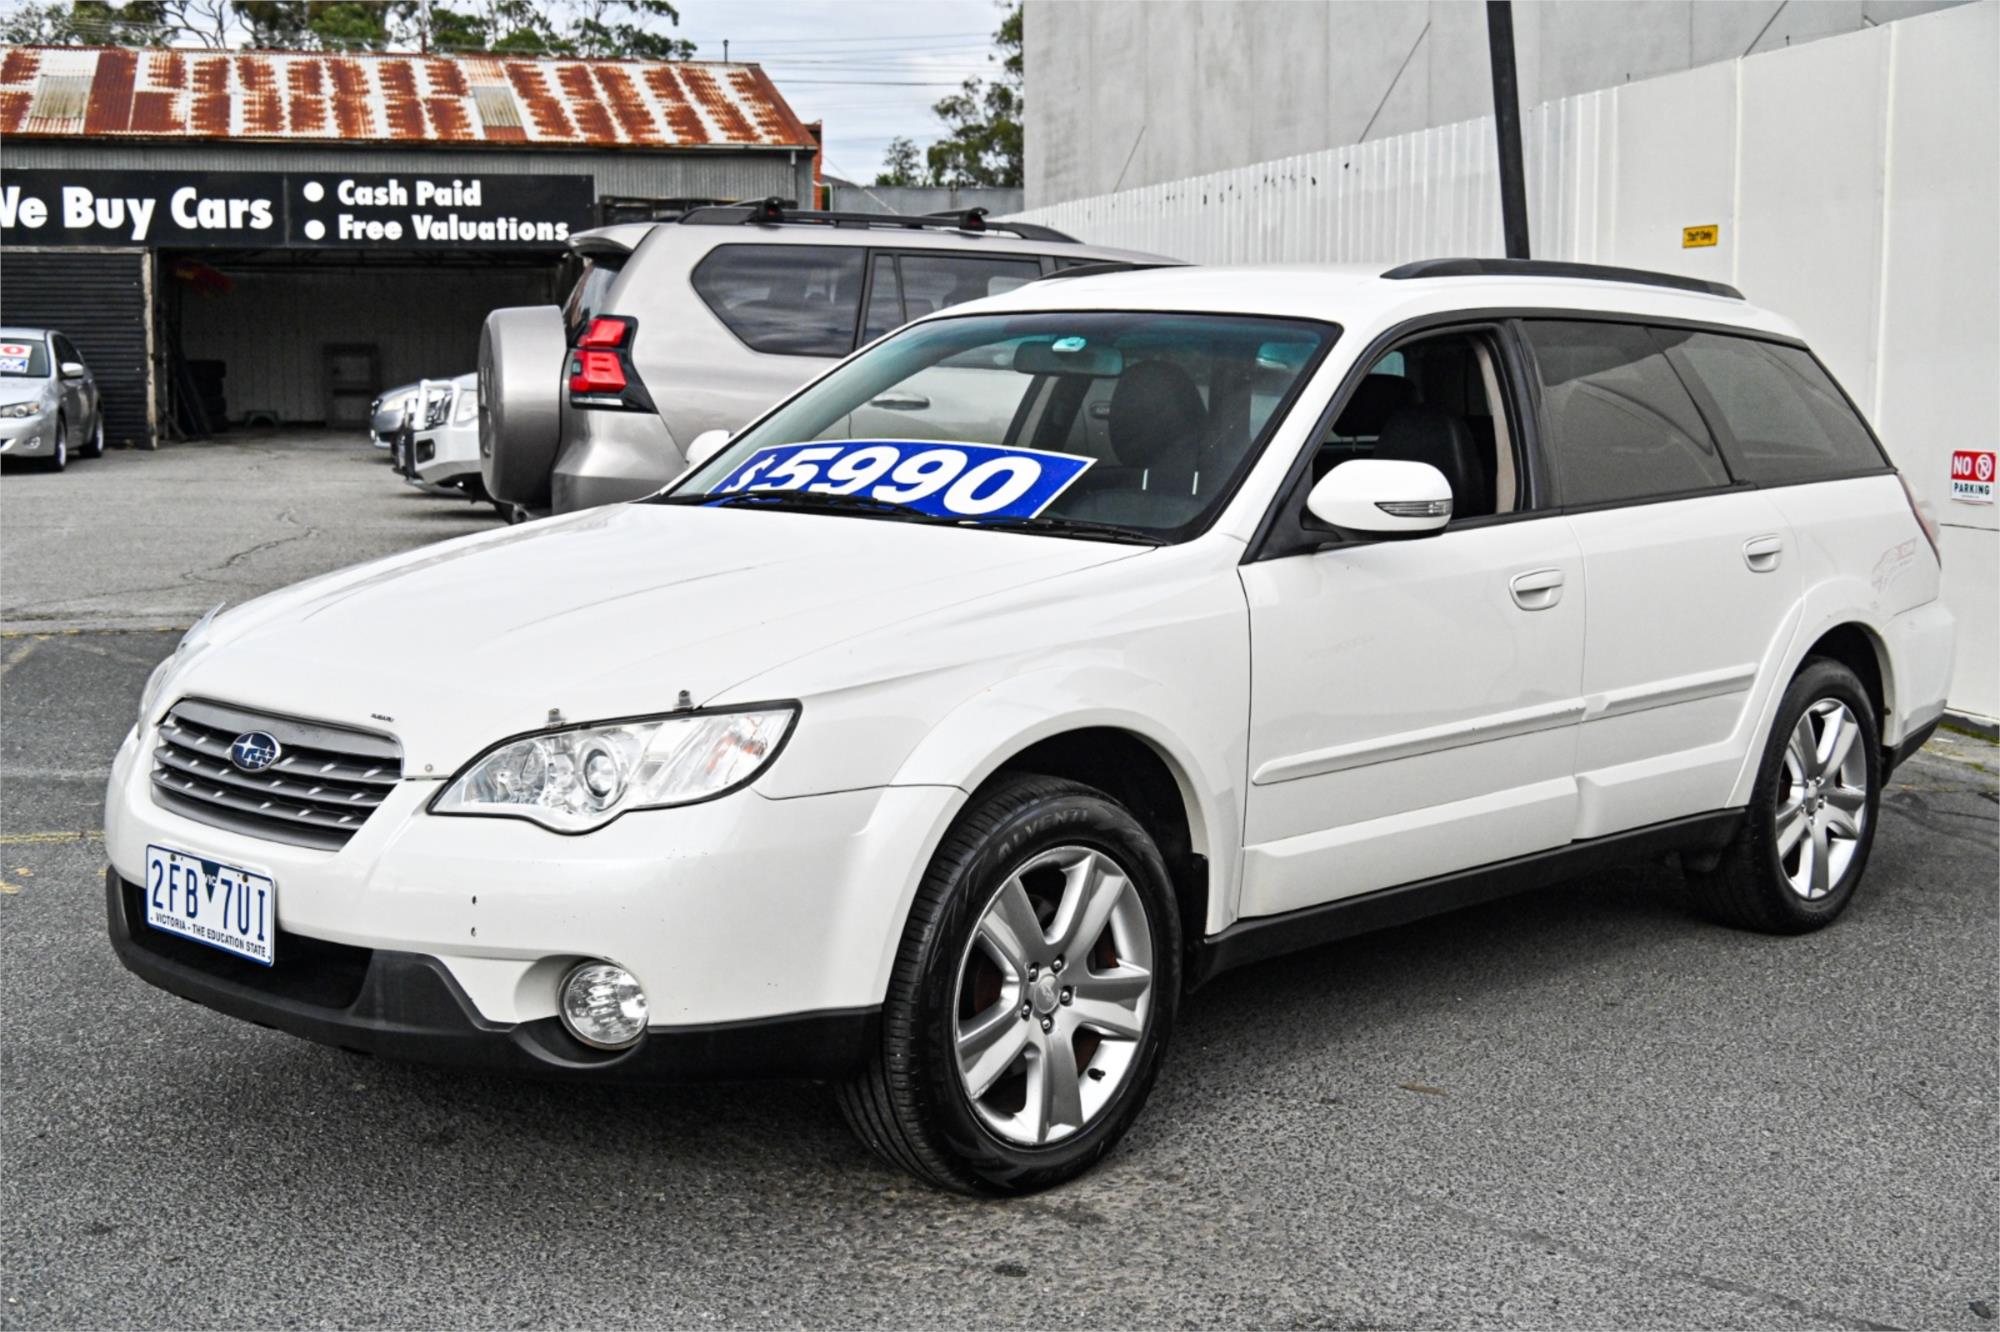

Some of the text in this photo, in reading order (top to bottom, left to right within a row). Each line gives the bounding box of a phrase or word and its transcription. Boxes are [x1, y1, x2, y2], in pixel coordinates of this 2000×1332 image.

[338, 179, 482, 206] Cash Paid
[62, 186, 156, 241] Buy
[170, 186, 273, 229] Cars
[338, 213, 570, 241] Free Valuations
[720, 446, 1041, 514] $5990
[1953, 455, 1972, 476] NO
[1954, 482, 1989, 495] PARKING
[152, 859, 265, 942] 2FB 7UI
[155, 912, 186, 930] VICTORIA
[192, 923, 205, 937] THE
[207, 929, 244, 949] EDUCATION
[246, 941, 266, 958] STATE
